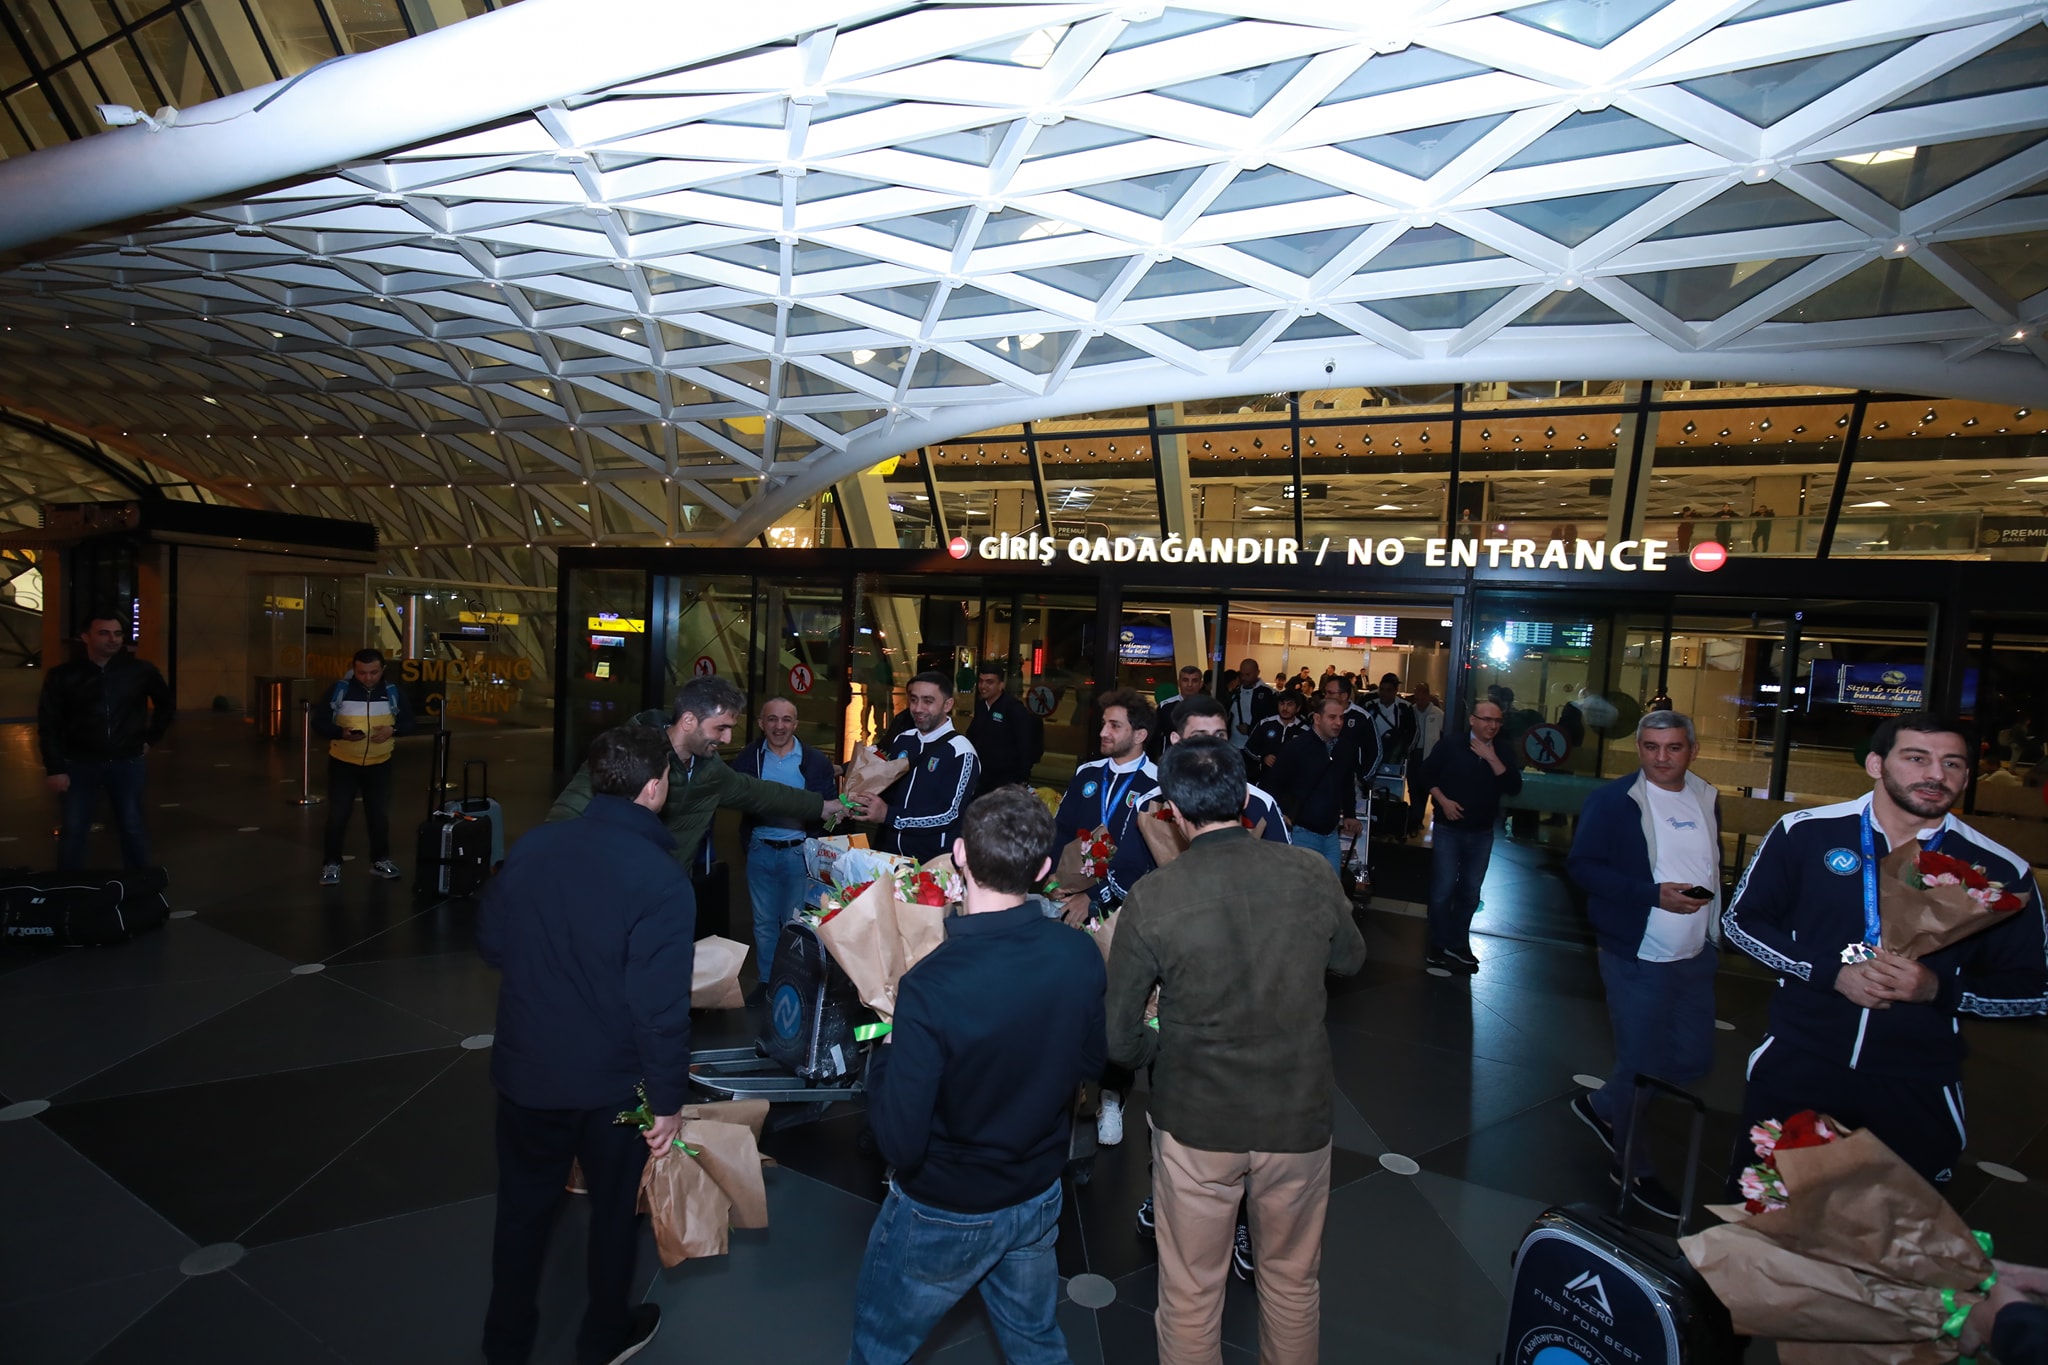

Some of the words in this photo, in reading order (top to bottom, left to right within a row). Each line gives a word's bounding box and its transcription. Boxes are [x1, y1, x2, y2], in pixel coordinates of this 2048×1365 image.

[819, 508, 827, 545] McDonald's
[977, 530, 1056, 567] GİRİŞ
[1067, 531, 1299, 570] QADAĞANDIR
[1315, 537, 1331, 567] /
[1346, 537, 1406, 568] NO
[1425, 537, 1669, 573] ENTRANCE
[401, 657, 532, 682] SMOKING
[1845, 684, 1870, 693] Sizin
[1852, 692, 1886, 700] burada
[424, 691, 511, 716] CABIN
[1533, 1288, 1569, 1316] FIRST
[1572, 1314, 1600, 1337] FOR
[1603, 1335, 1643, 1363] BEST
[1566, 1335, 1593, 1358] Cüdo
